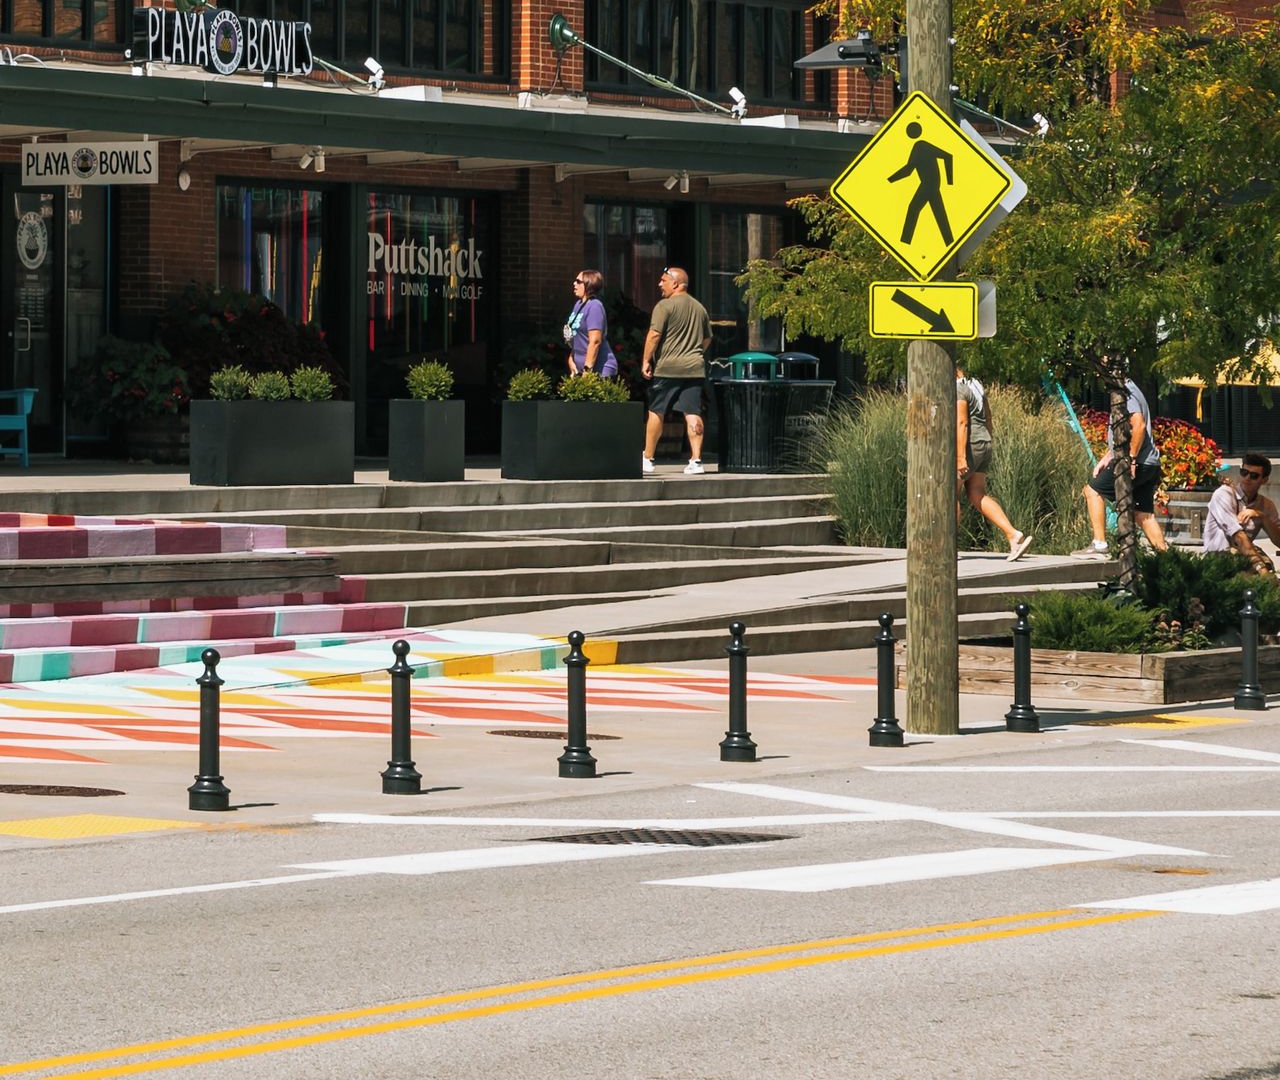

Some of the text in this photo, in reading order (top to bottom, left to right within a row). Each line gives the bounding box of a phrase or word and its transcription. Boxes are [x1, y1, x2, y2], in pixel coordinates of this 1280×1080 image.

[148, 7, 313, 77] PLAYA BOWLS
[26, 152, 70, 176] PLAYA
[100, 150, 152, 175] BOWLS
[367, 232, 483, 278] Puttshack
[367, 281, 385, 295] BAR
[400, 282, 429, 296] DINING
[461, 286, 483, 299] GOLF
